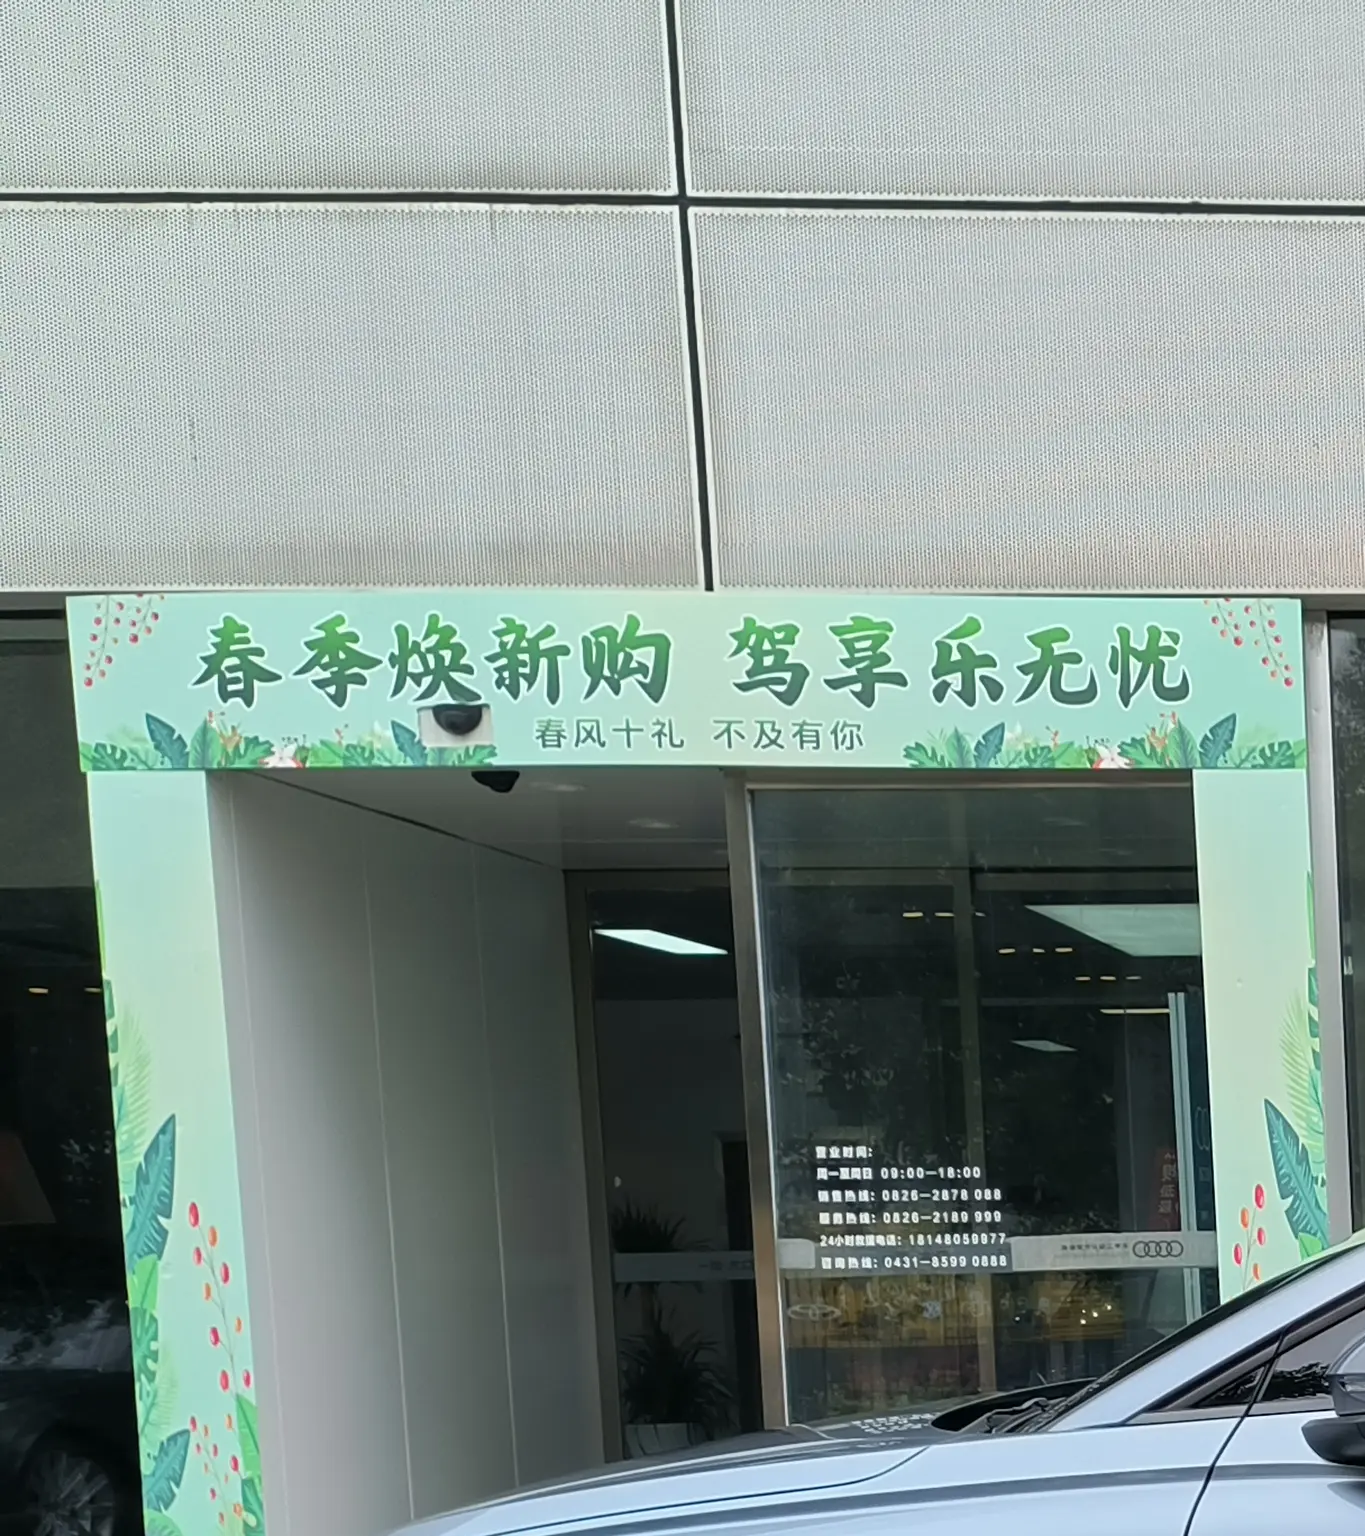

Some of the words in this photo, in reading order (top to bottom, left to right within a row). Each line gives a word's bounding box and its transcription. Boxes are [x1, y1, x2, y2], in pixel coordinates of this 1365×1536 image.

[190, 612, 674, 708] 春季焕新购
[726, 614, 1192, 708] 驾享乐无忧
[533, 716, 687, 751] 春风十礼
[711, 718, 866, 752] 不及有你
